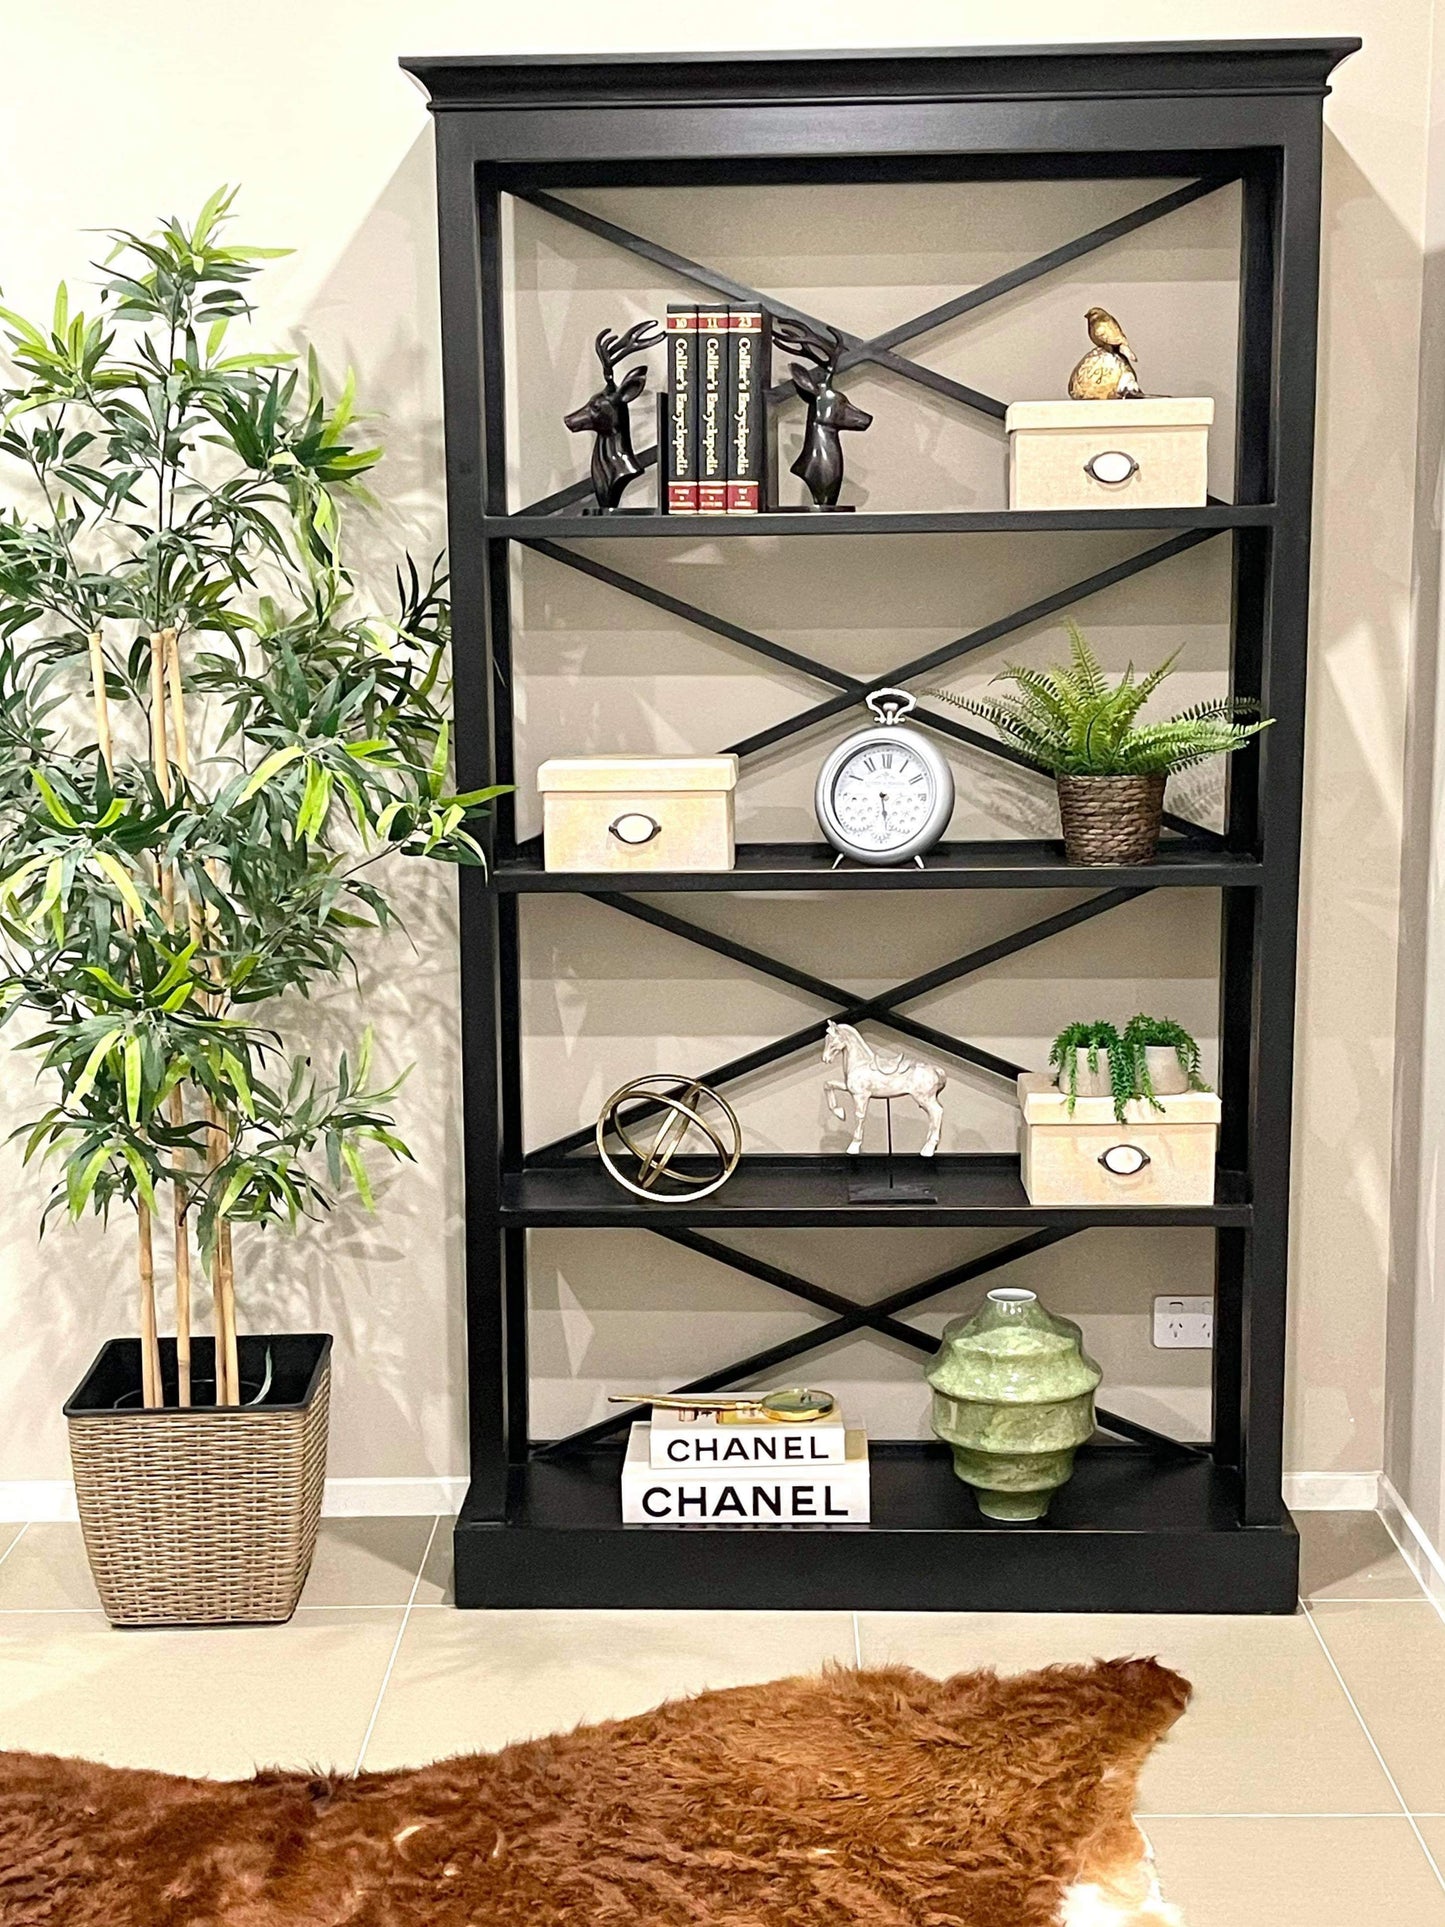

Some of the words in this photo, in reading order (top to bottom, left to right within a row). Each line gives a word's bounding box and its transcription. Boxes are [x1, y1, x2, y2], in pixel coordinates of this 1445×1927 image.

[675, 318, 688, 328] 10
[707, 318, 718, 329] 11
[676, 338, 688, 391] Collier's
[707, 338, 719, 391] Collier's
[739, 337, 751, 390] Collier's
[672, 392, 688, 475] Encyclopedia
[702, 392, 719, 475] Encyclopedia
[733, 392, 750, 475] Encyclopedia
[667, 1436, 829, 1462] CHANEL
[641, 1485, 849, 1518] CHANEL
